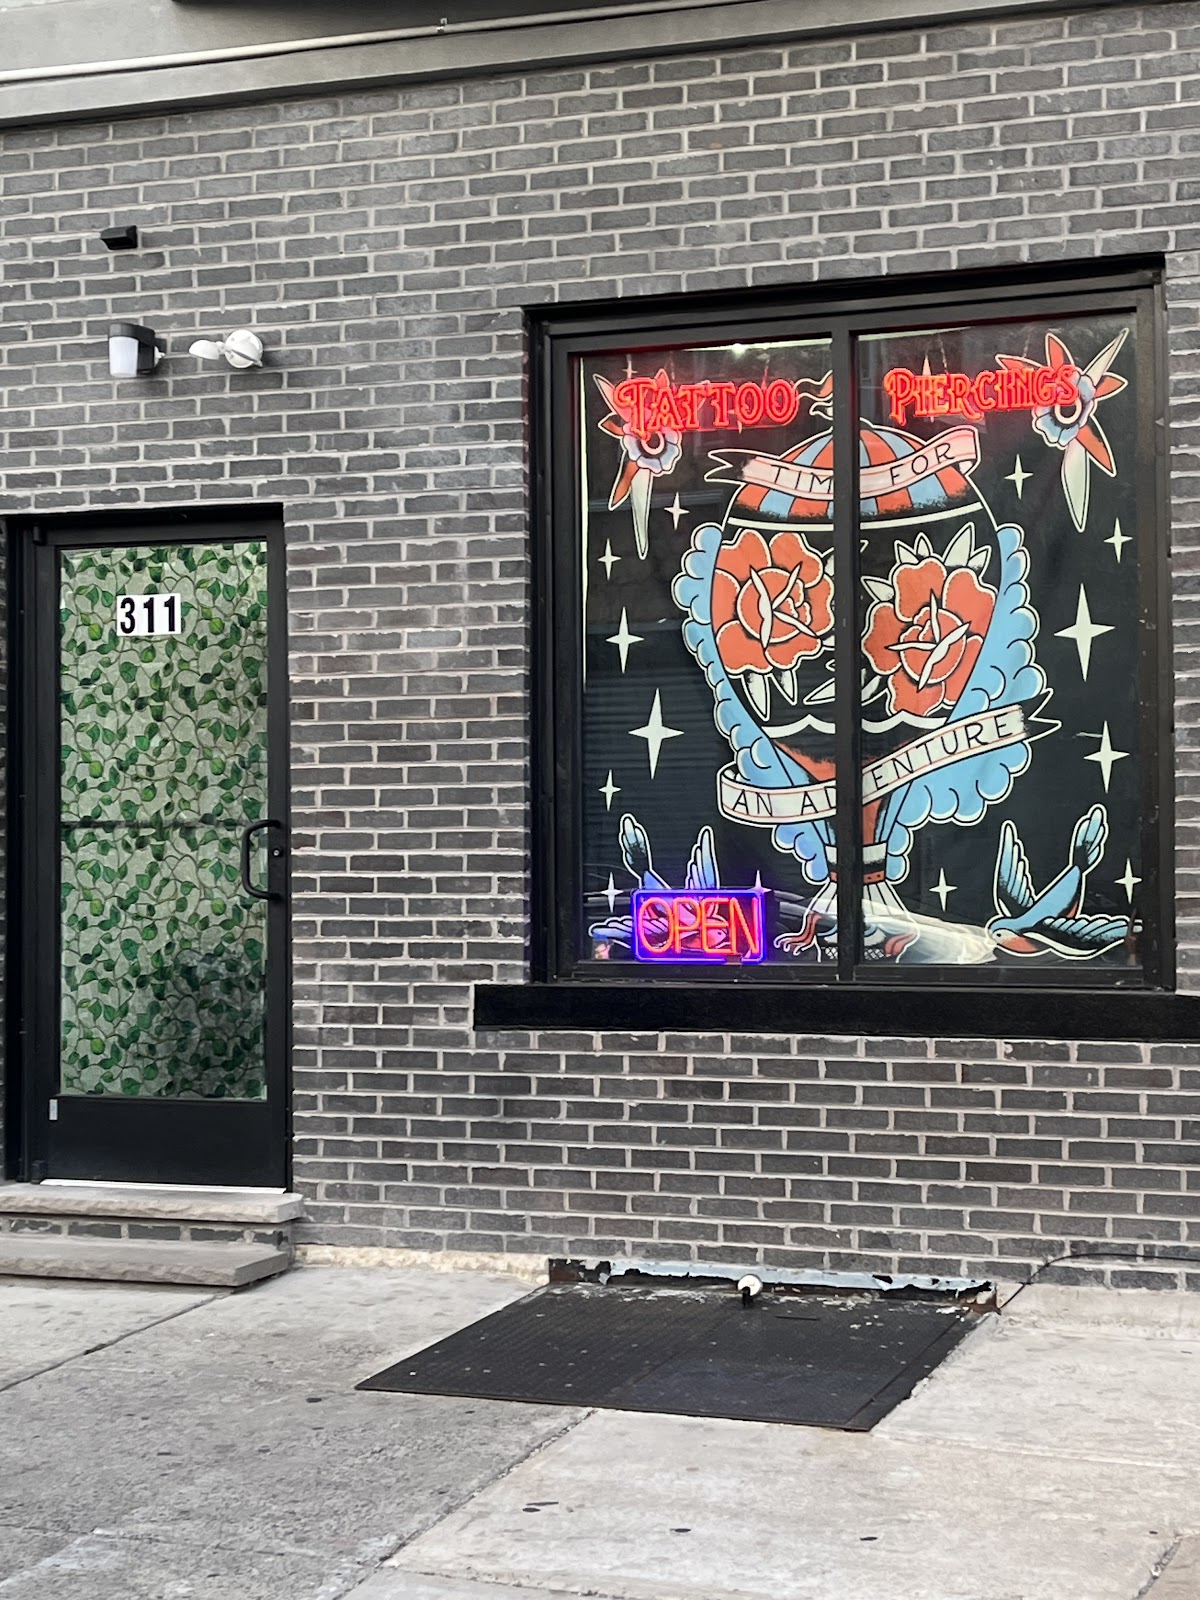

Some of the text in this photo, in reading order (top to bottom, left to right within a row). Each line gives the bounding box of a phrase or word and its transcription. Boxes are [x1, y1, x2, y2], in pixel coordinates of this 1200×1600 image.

[613, 377, 799, 441] TATTOO
[883, 364, 1080, 426] PIERCINGS
[770, 442, 955, 494] TIM FOR
[120, 596, 175, 634] 311
[733, 711, 1014, 817] AN ADENTURE
[638, 897, 760, 955] OPEN
